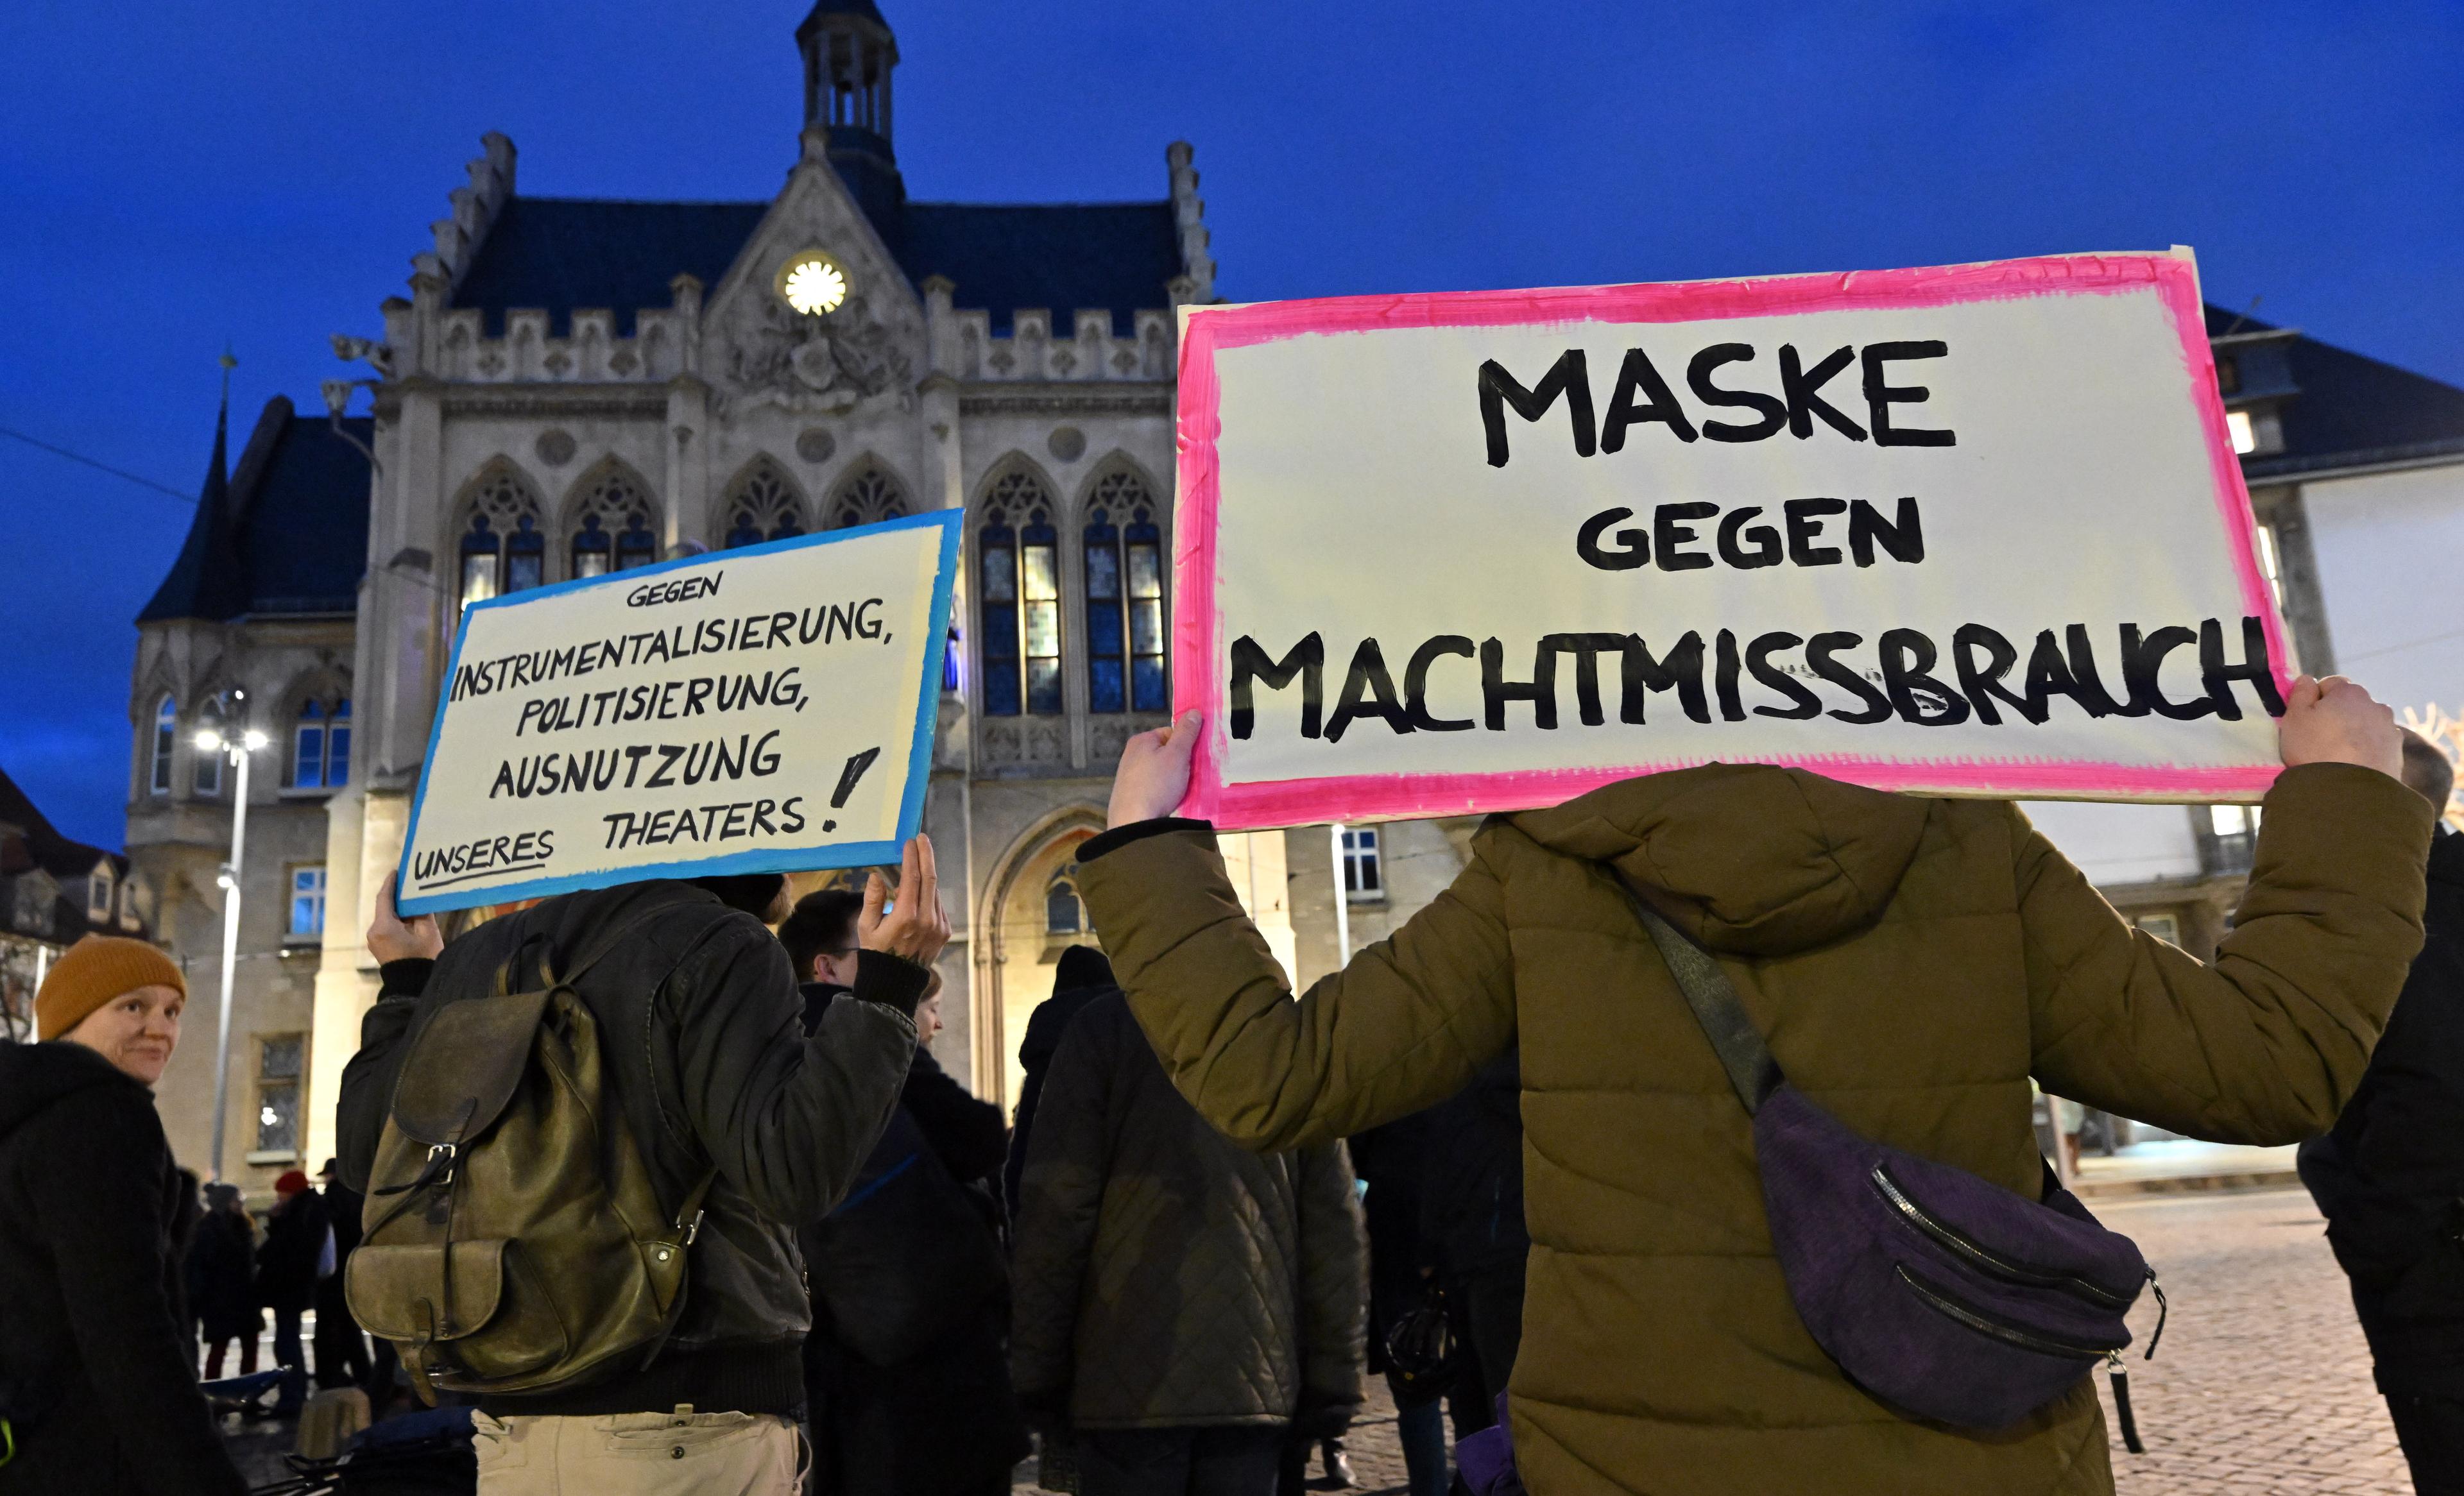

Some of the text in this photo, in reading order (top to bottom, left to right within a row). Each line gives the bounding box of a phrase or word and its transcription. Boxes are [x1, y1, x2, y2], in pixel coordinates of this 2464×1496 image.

[1478, 340, 1956, 468] MASKE
[1577, 497, 1924, 572] GEGEN
[627, 571, 724, 607] GEGEN
[450, 599, 893, 701] INSTRUMENTALISIERUNG,
[1230, 616, 2285, 744] MACHTMISSBRAUCH
[517, 668, 809, 736] POLITISIERUNG,
[490, 730, 781, 798] AUSNUTZUNG
[415, 831, 553, 881] UNSERES
